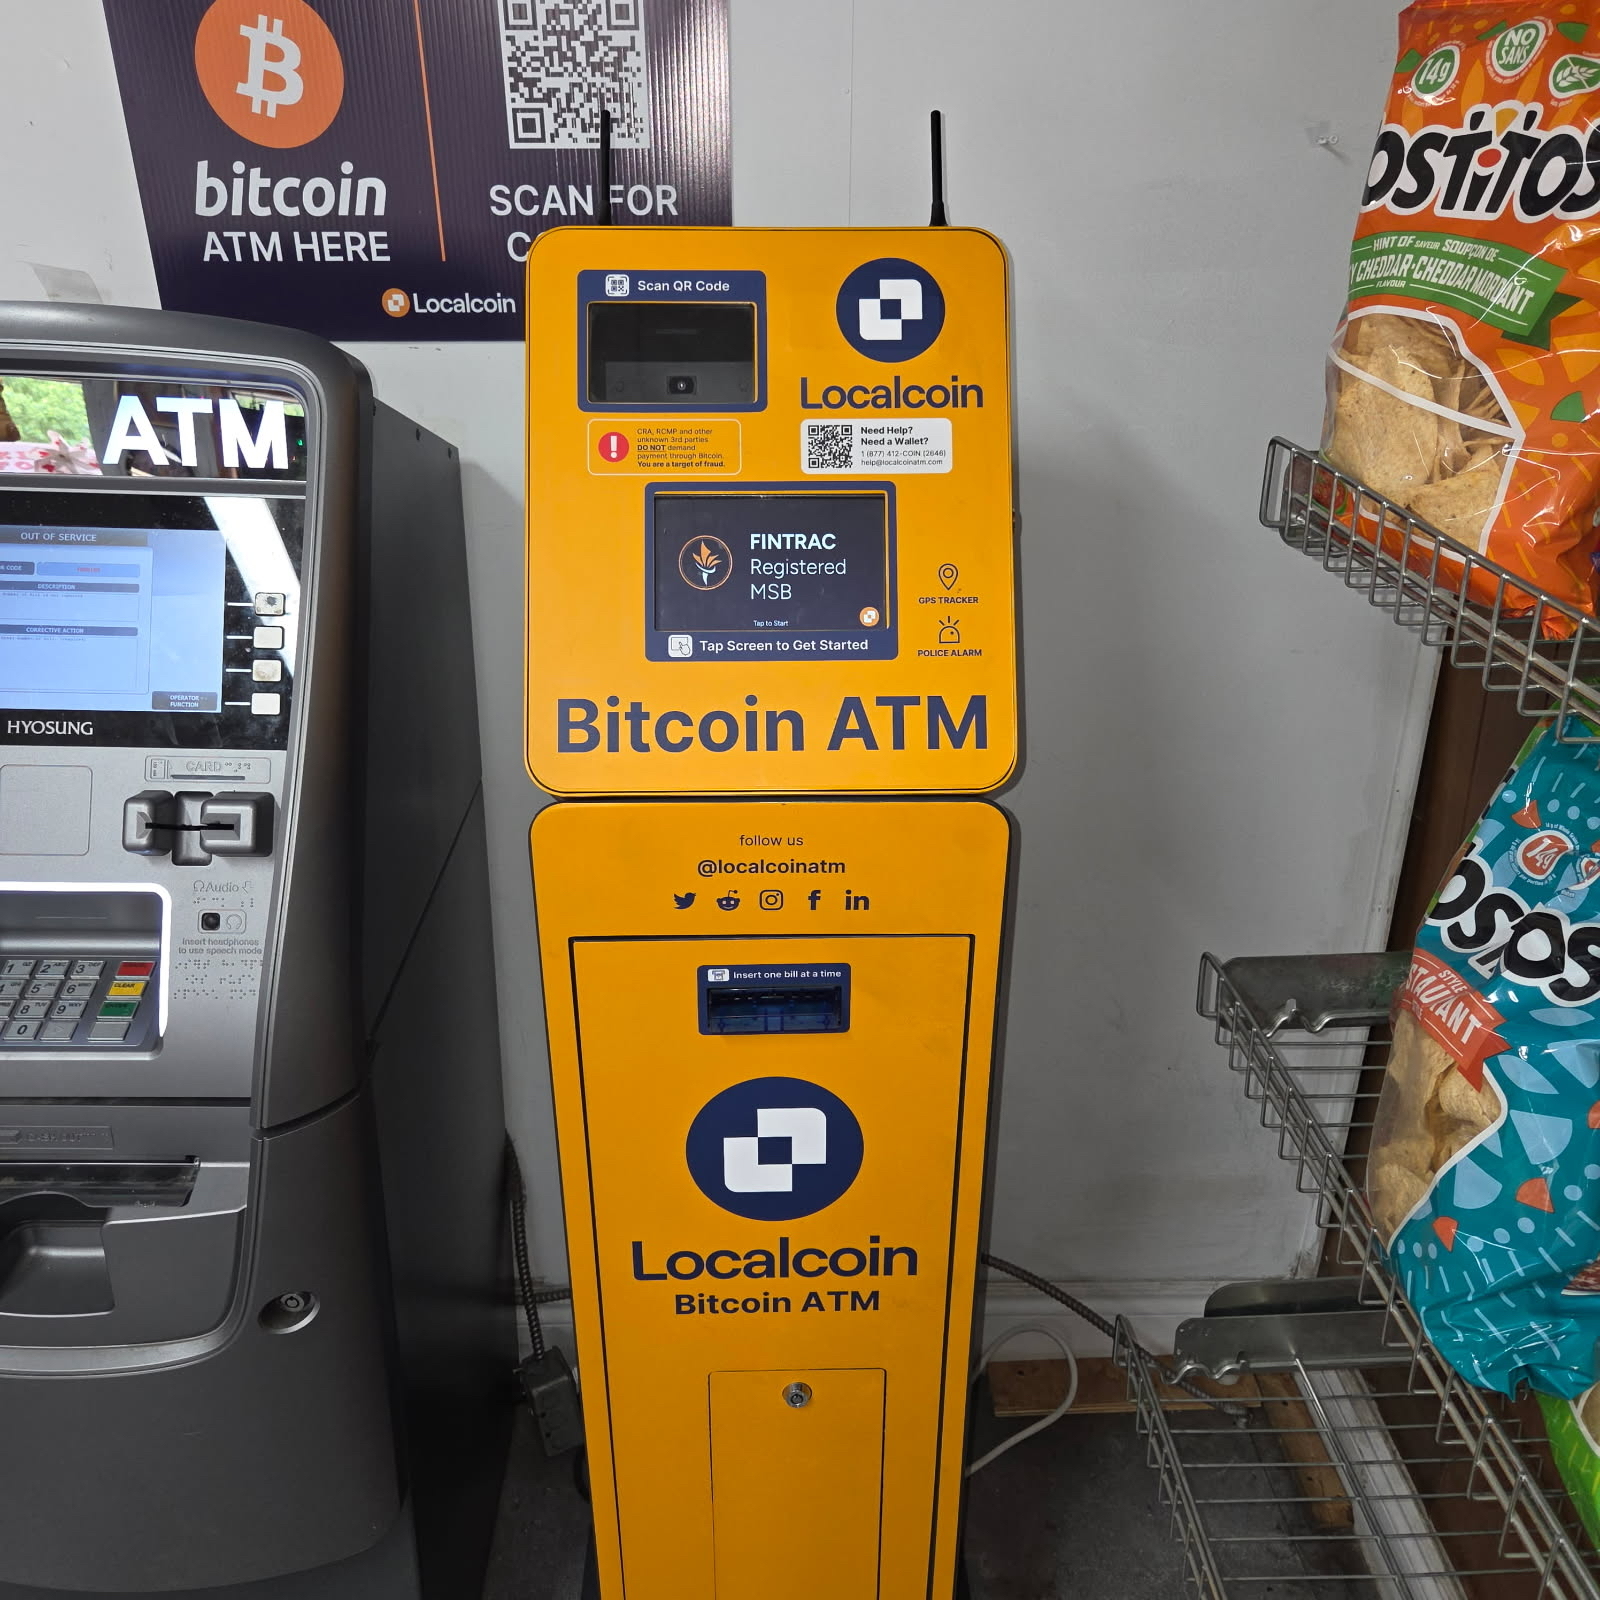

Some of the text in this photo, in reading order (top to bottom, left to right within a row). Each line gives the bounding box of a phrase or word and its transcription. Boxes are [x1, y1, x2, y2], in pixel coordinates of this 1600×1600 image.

[1504, 28, 1536, 46] NO
[1498, 46, 1530, 64] SANS
[1418, 58, 1452, 84] 14g
[195, 160, 387, 216] bitcoin
[489, 184, 594, 217] SCAN
[202, 232, 391, 262] ATM HERE
[1373, 236, 1500, 262] HINT OF SAVEUR SOUPÇON DE
[638, 280, 730, 293] Scan QR Code
[1376, 280, 1406, 288] FLAVOUR
[1472, 268, 1535, 315] MORDANT
[412, 293, 516, 314] Localcoin
[800, 376, 984, 409] Localcoin
[103, 395, 288, 470] ATM
[886, 426, 912, 436] Help?
[860, 438, 884, 446] Need
[894, 437, 928, 446] Wallet?
[20, 532, 97, 542] OUT OF SERVICE
[750, 534, 836, 550] FINTRAC
[750, 558, 846, 579] Registered
[750, 584, 792, 600] MSB
[700, 639, 868, 654] Tap Screen to Get Started
[7, 720, 94, 736] HYOSUNG
[557, 694, 988, 753] Bitcoin ATM
[186, 760, 222, 772] CARD
[739, 834, 804, 847] follow us
[697, 858, 845, 878] @localcoinatm
[205, 880, 239, 892] Audio
[182, 938, 260, 947] Insert headphones
[206, 947, 236, 956] speech
[7, 964, 14, 973] 1
[40, 964, 51, 974] 2
[76, 964, 85, 974] 3
[733, 970, 762, 979] Insert
[784, 970, 798, 978] bill
[820, 970, 842, 978] time
[31, 984, 40, 994] 5
[66, 984, 76, 994] 6
[1438, 969, 1468, 994] STYLE
[20, 1004, 30, 1014] 8
[56, 1005, 66, 1014] 9
[18, 1024, 28, 1035] 0
[632, 1235, 918, 1281] Localcoin
[675, 1291, 880, 1315] Bitcoin ATM
